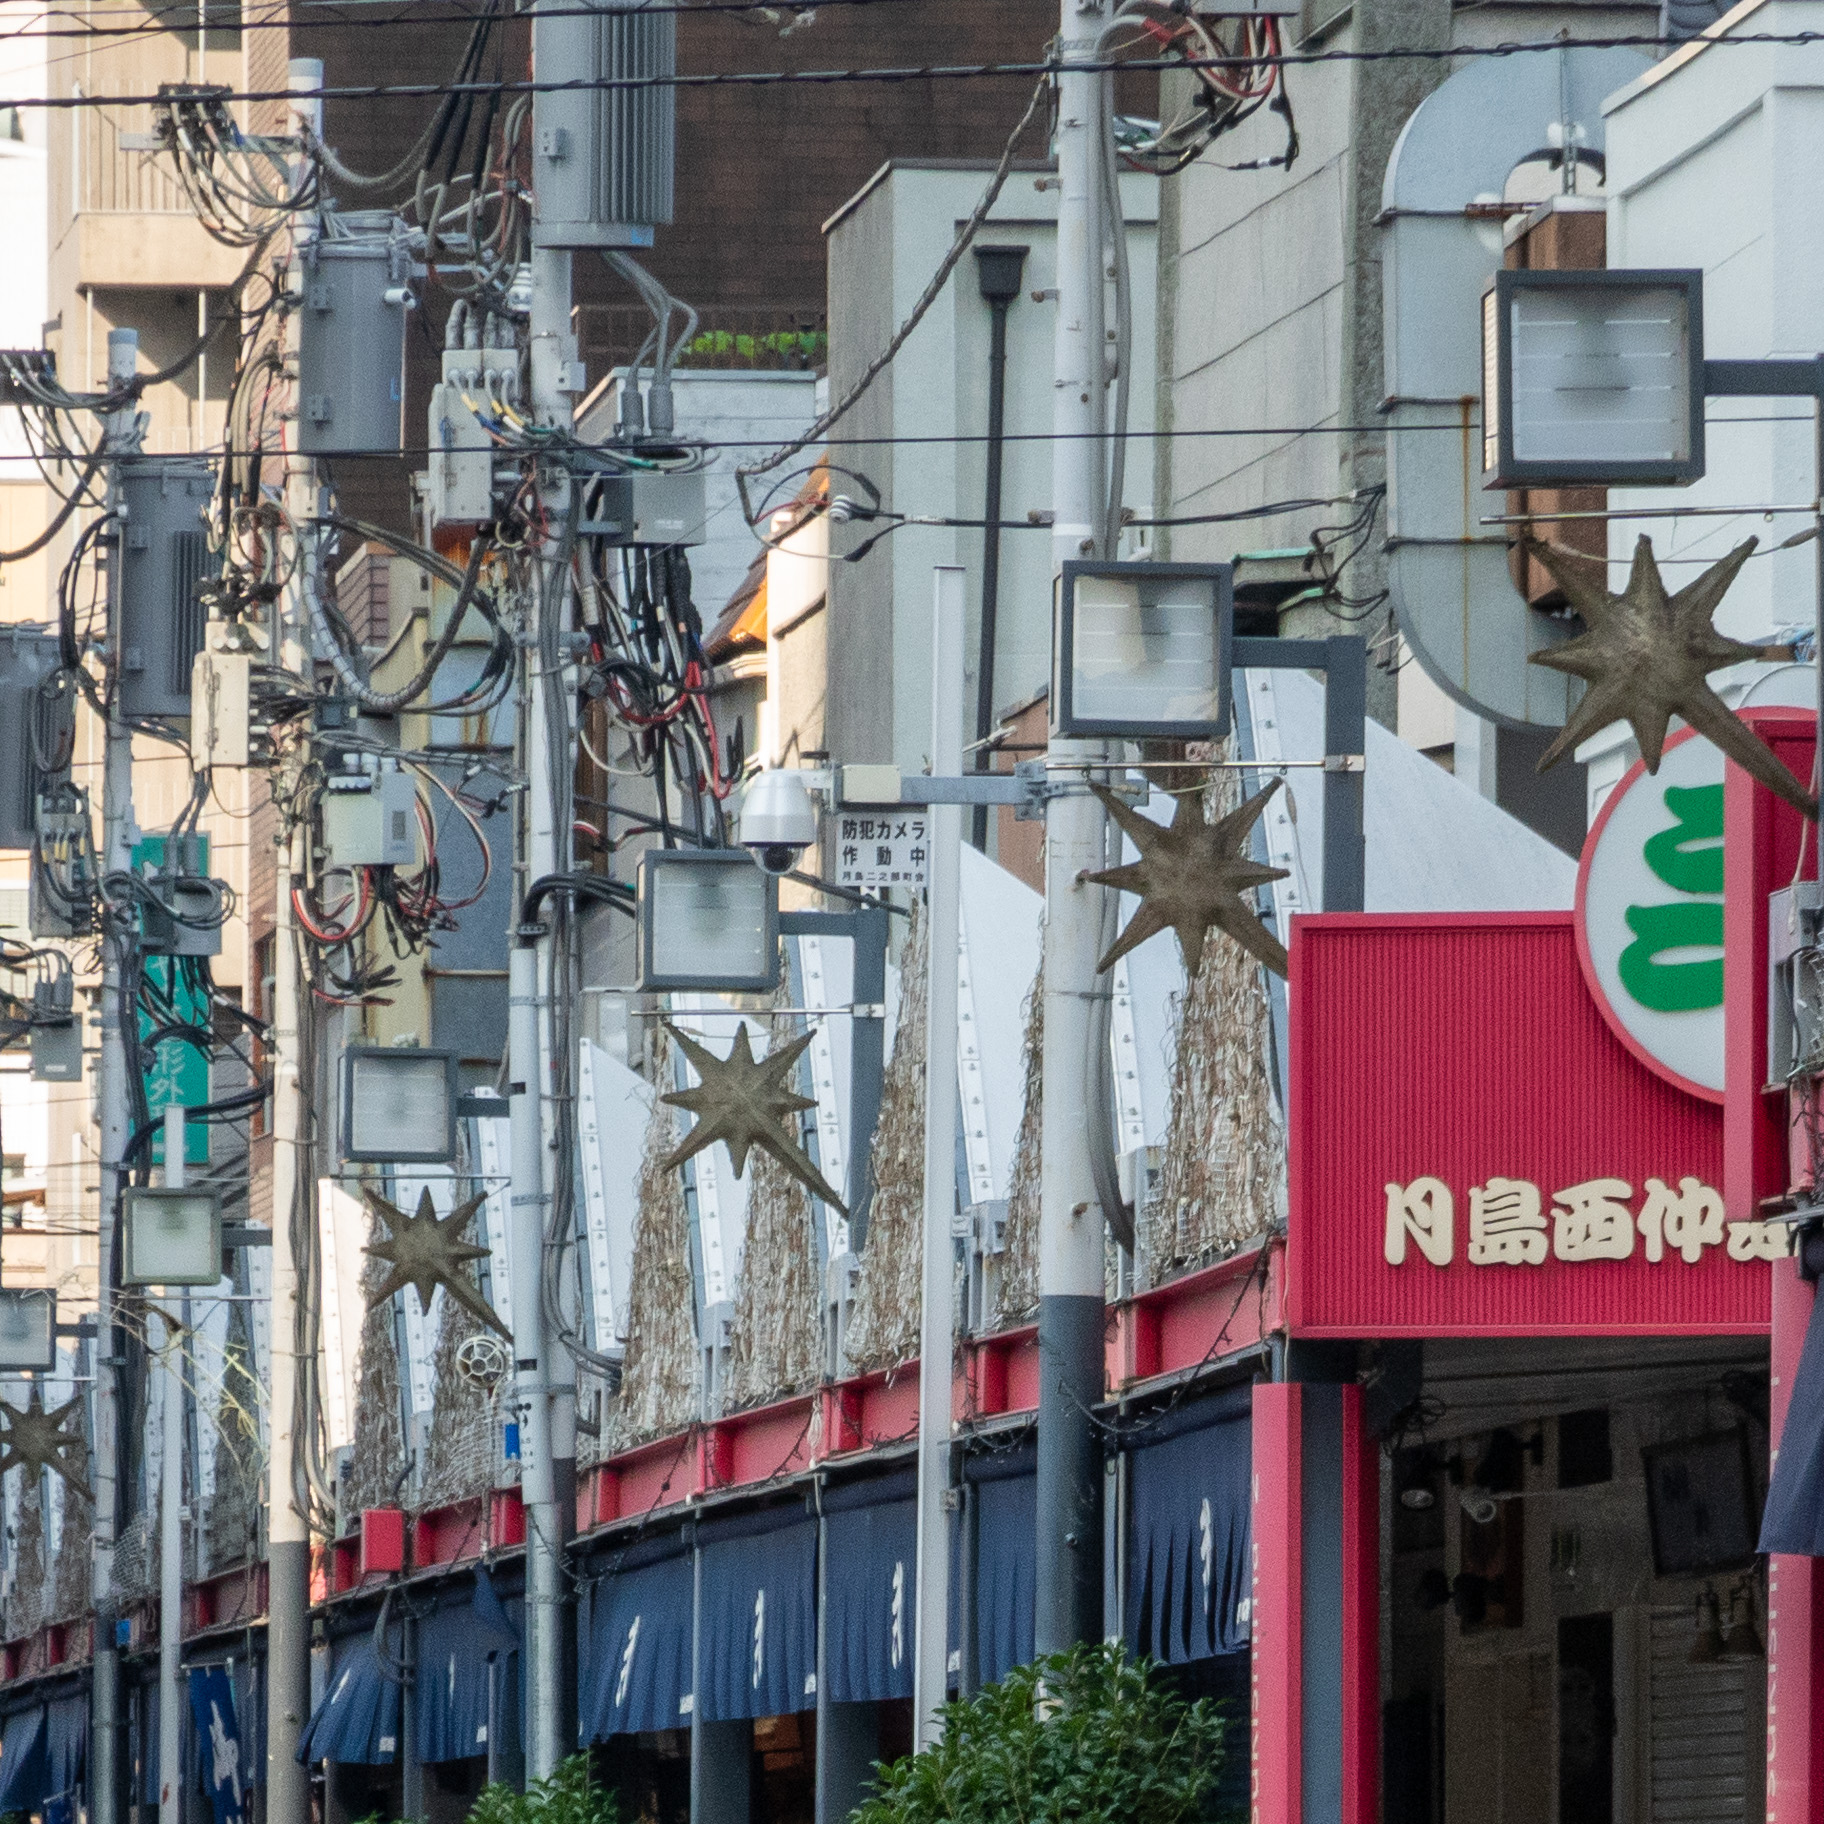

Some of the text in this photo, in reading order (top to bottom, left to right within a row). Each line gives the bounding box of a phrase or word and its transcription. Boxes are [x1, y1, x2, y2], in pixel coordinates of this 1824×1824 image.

[842, 819, 925, 840] 防犯カメラ
[842, 845, 925, 868] 作動中
